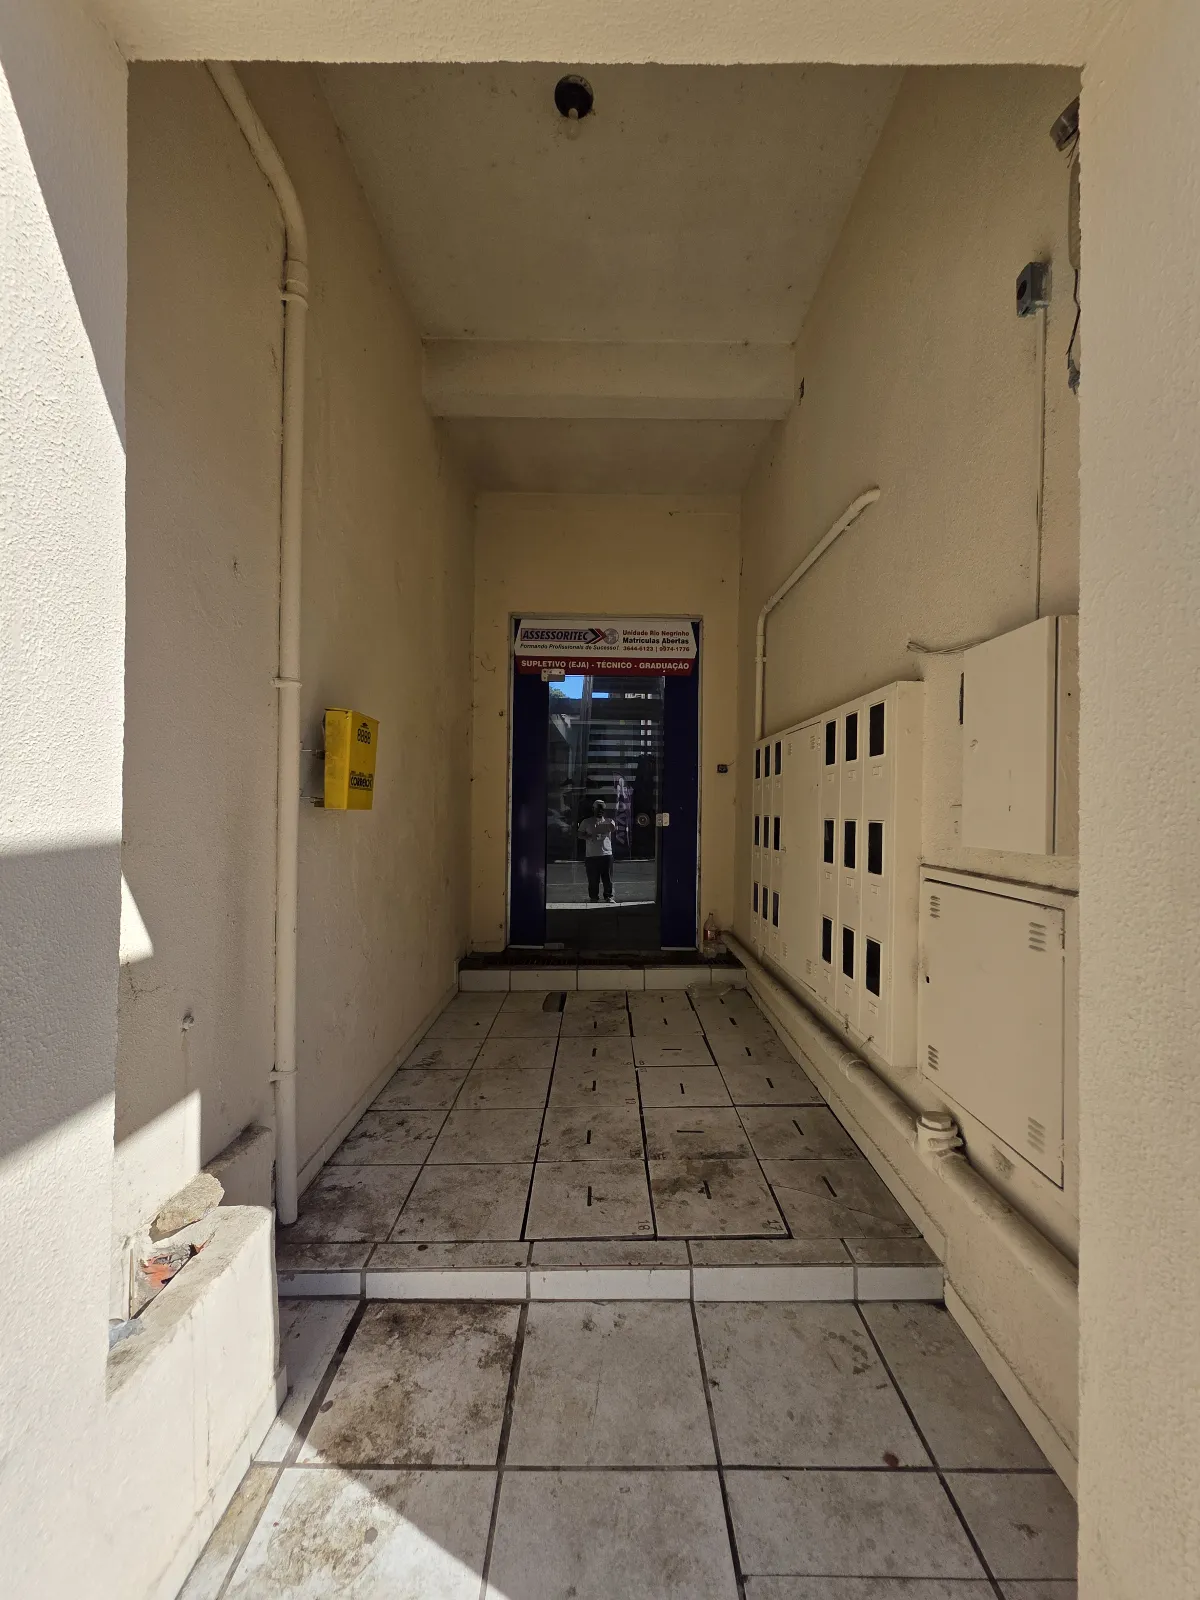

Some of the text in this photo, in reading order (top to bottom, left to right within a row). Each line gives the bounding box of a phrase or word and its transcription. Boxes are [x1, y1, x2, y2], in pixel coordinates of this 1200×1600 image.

[522, 630, 590, 641] ASSESSORITEC
[521, 660, 567, 668] SUPLETIVO
[568, 661, 589, 669] (EJA)
[596, 659, 633, 669] TÉCNICO
[639, 660, 690, 671] GRADUAÇÃO
[637, 1219, 651, 1231] 18
[766, 1219, 784, 1231] 17
